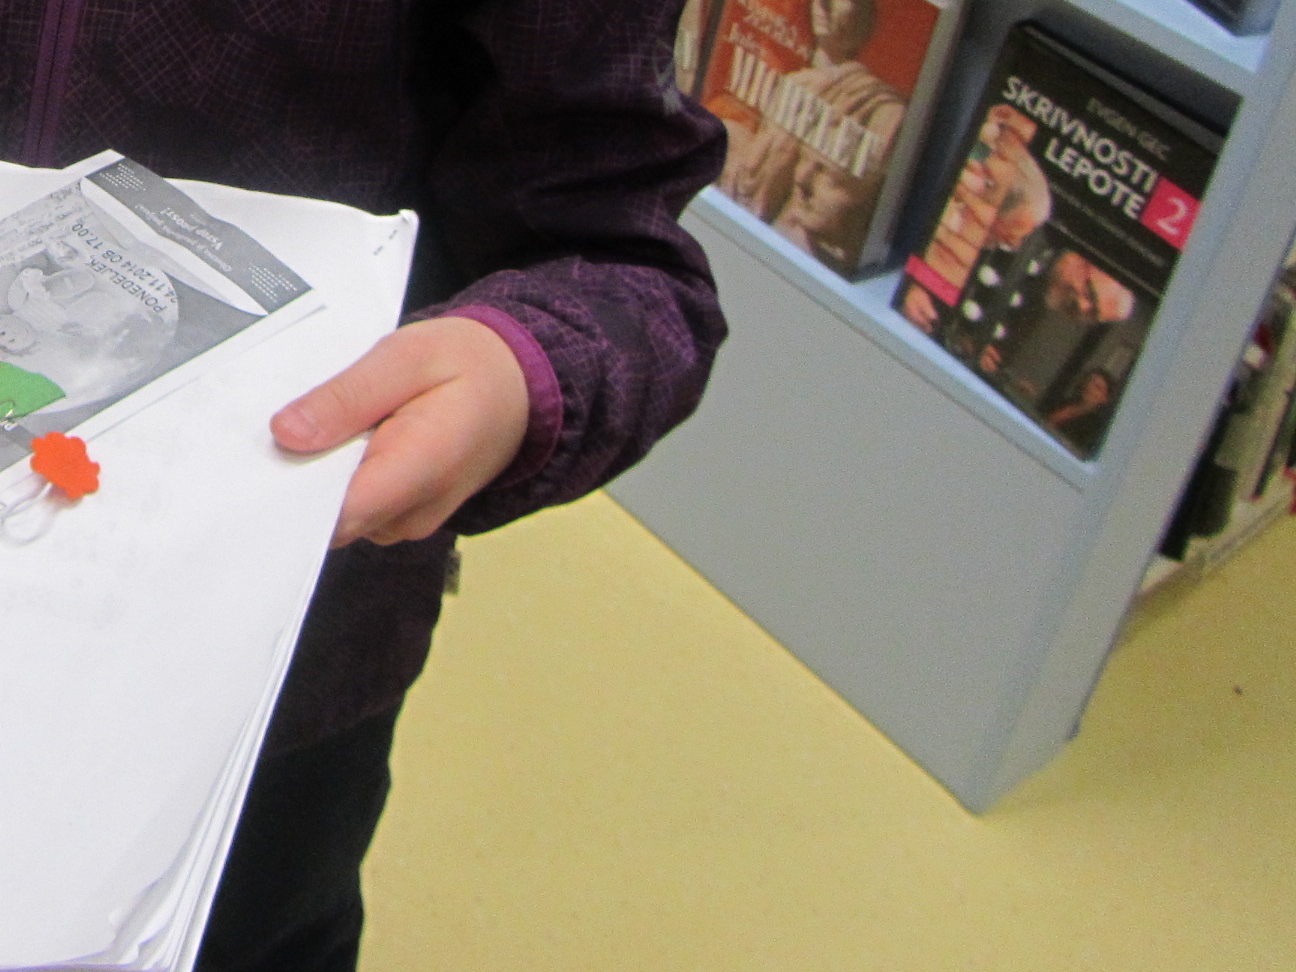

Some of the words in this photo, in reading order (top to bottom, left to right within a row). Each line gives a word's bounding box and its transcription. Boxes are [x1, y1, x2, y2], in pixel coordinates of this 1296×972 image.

[1002, 76, 1159, 194] SKRIVNOSTI
[1044, 137, 1146, 219] LEPOTE
[1156, 197, 1188, 236] 2
[88, 254, 167, 313] PONEDELJEK,
[102, 249, 123, 264] OB
